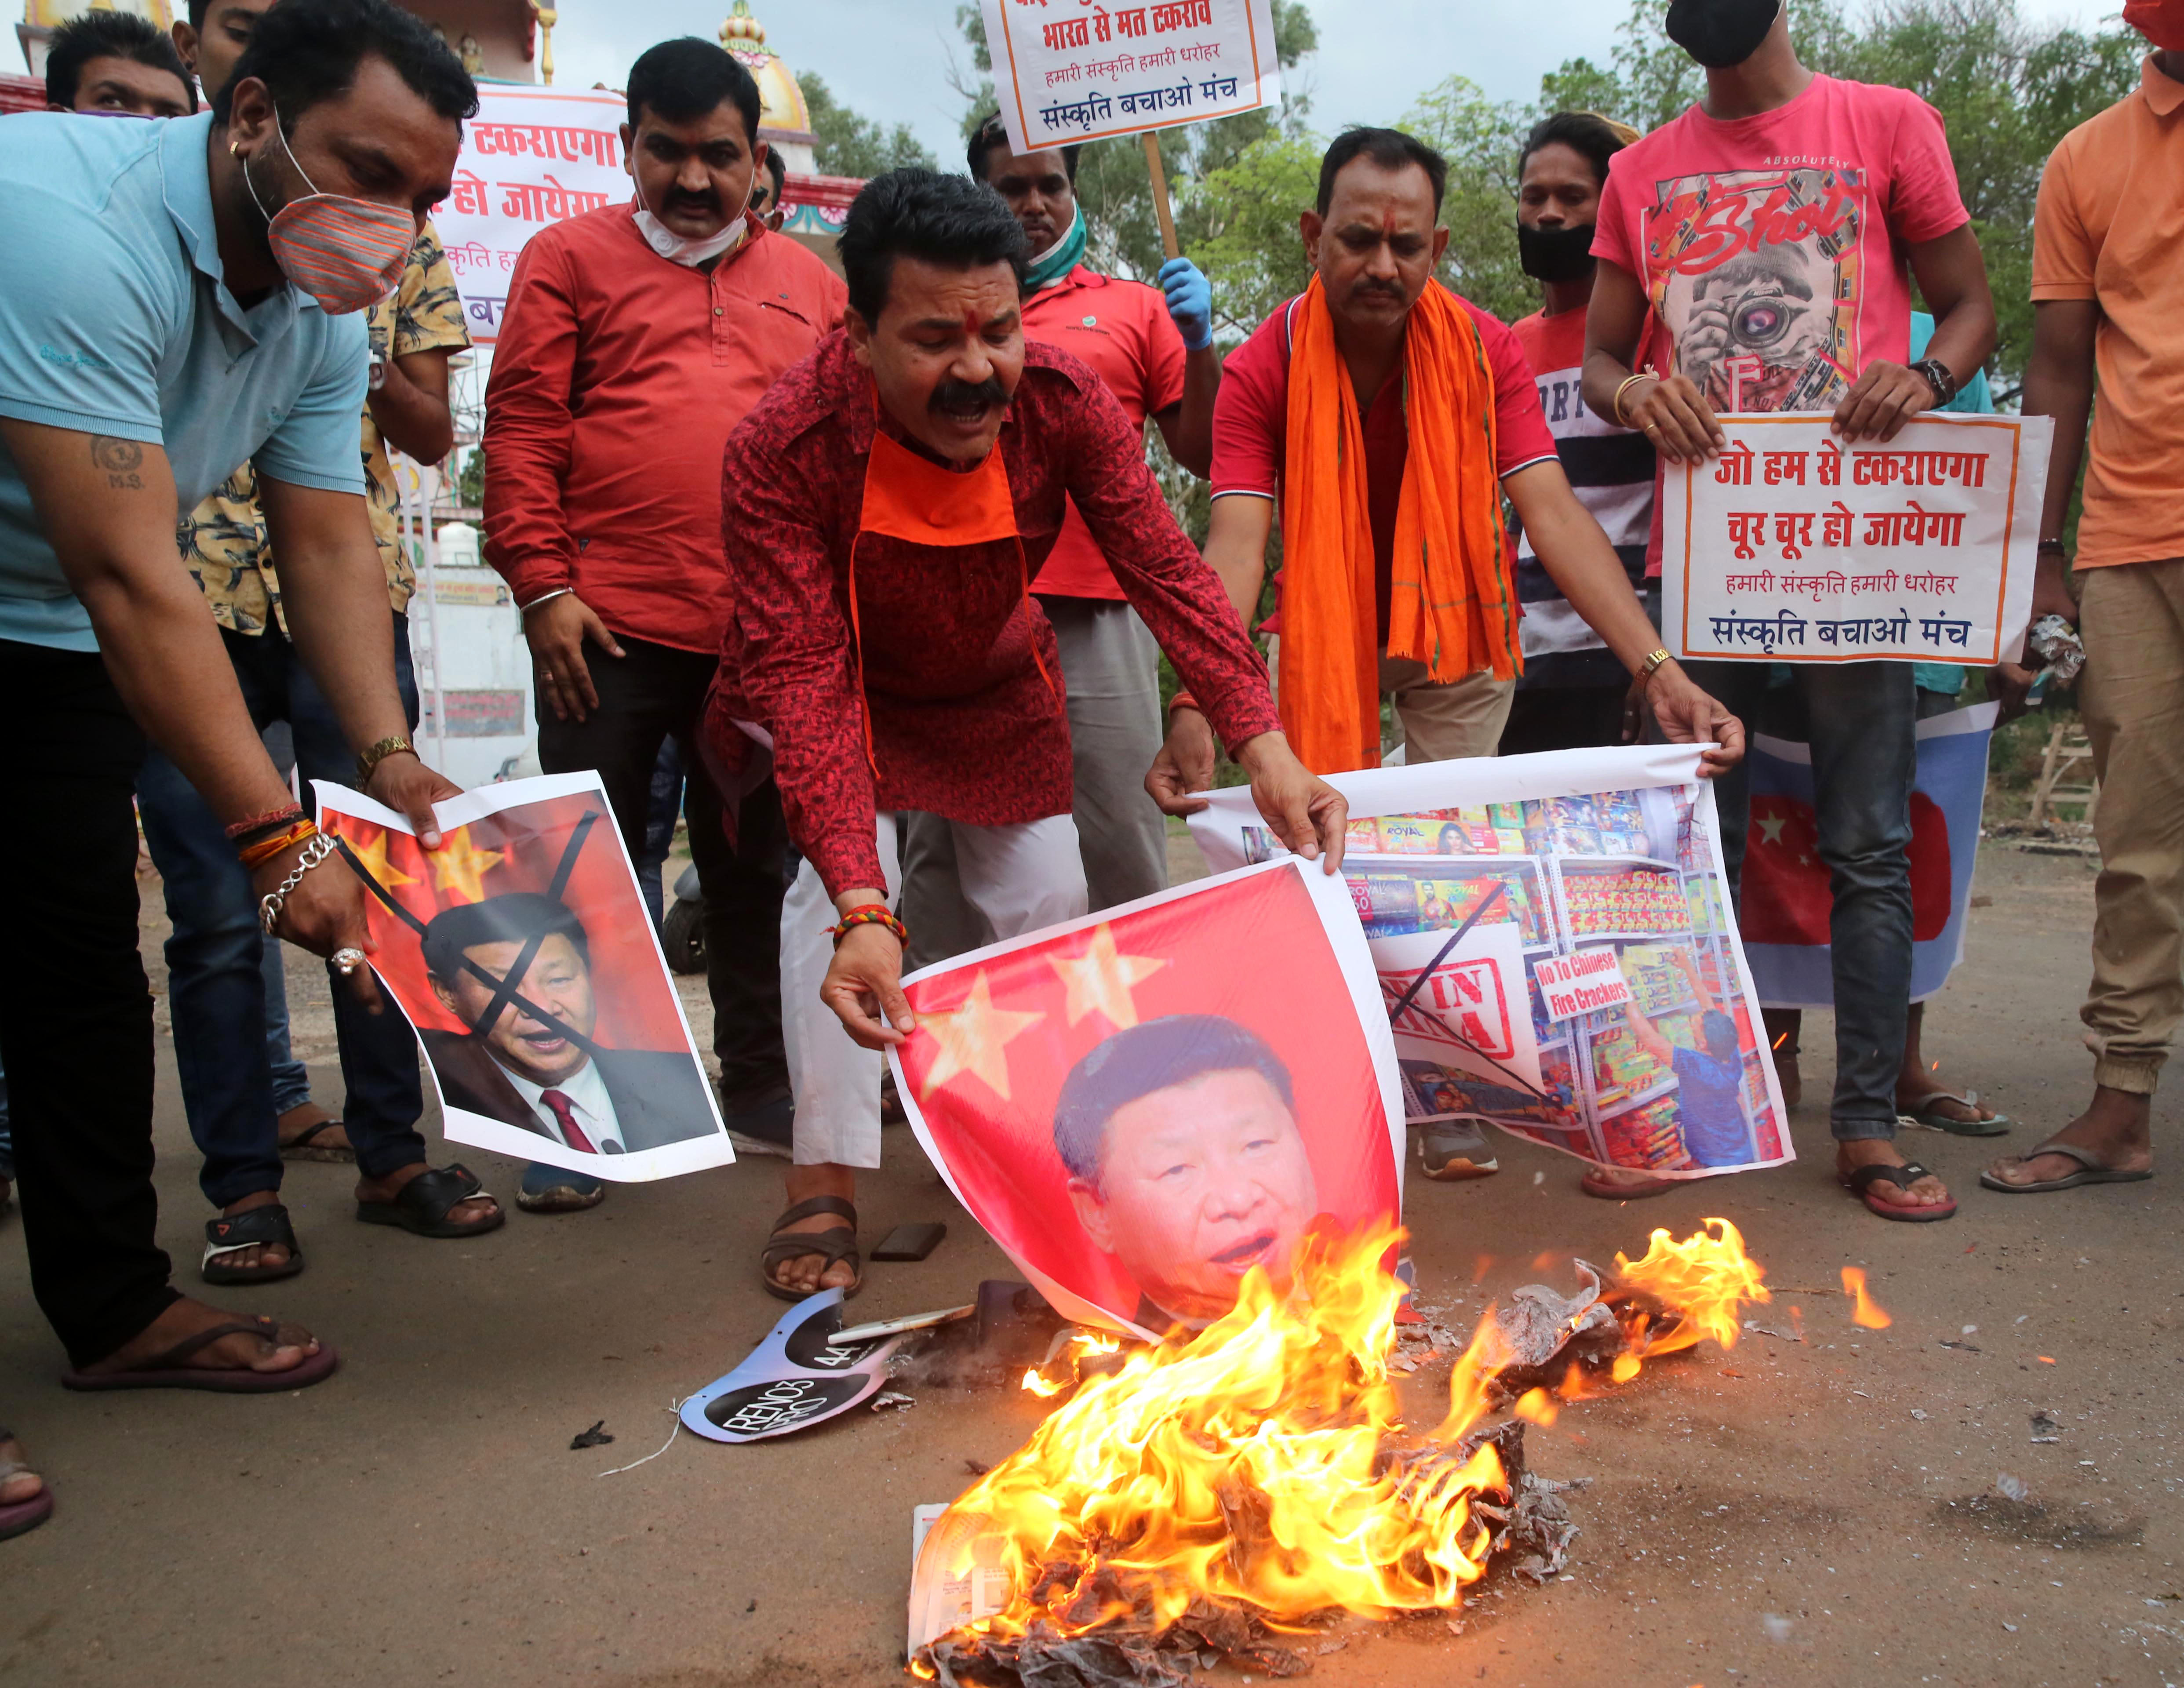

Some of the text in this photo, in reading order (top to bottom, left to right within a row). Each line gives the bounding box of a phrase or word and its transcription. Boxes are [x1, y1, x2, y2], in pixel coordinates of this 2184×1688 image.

[1044, 18, 1088, 50] भारत
[1093, 6, 1111, 43] से
[1116, 8, 1147, 38] मत
[1045, 43, 1220, 87] हमारी संस्कृति हमारी धरोहर
[1039, 73, 1238, 131] संस्कृति बचाओ मंच
[470, 122, 616, 167] टकराएगा
[1763, 155, 1849, 169] ABSOLUTELY
[451, 169, 488, 216] हो
[1714, 440, 1989, 487] जो हम से टकराएगा
[1728, 501, 1966, 560] चूर चूर हो जायेगा
[1726, 569, 1959, 603] हमारी संस्कृति हमारी धरोहर
[1709, 608, 1973, 655] संस्कृति बचाओ मंच
[1387, 826, 1424, 837] ROYAL
[1427, 969, 1483, 1009] IN
[1536, 952, 1616, 987] No To Chinese
[1550, 982, 1628, 1016] Fire Crackers
[723, 1379, 815, 1431] RENO3
[762, 1397, 828, 1431] PRO
